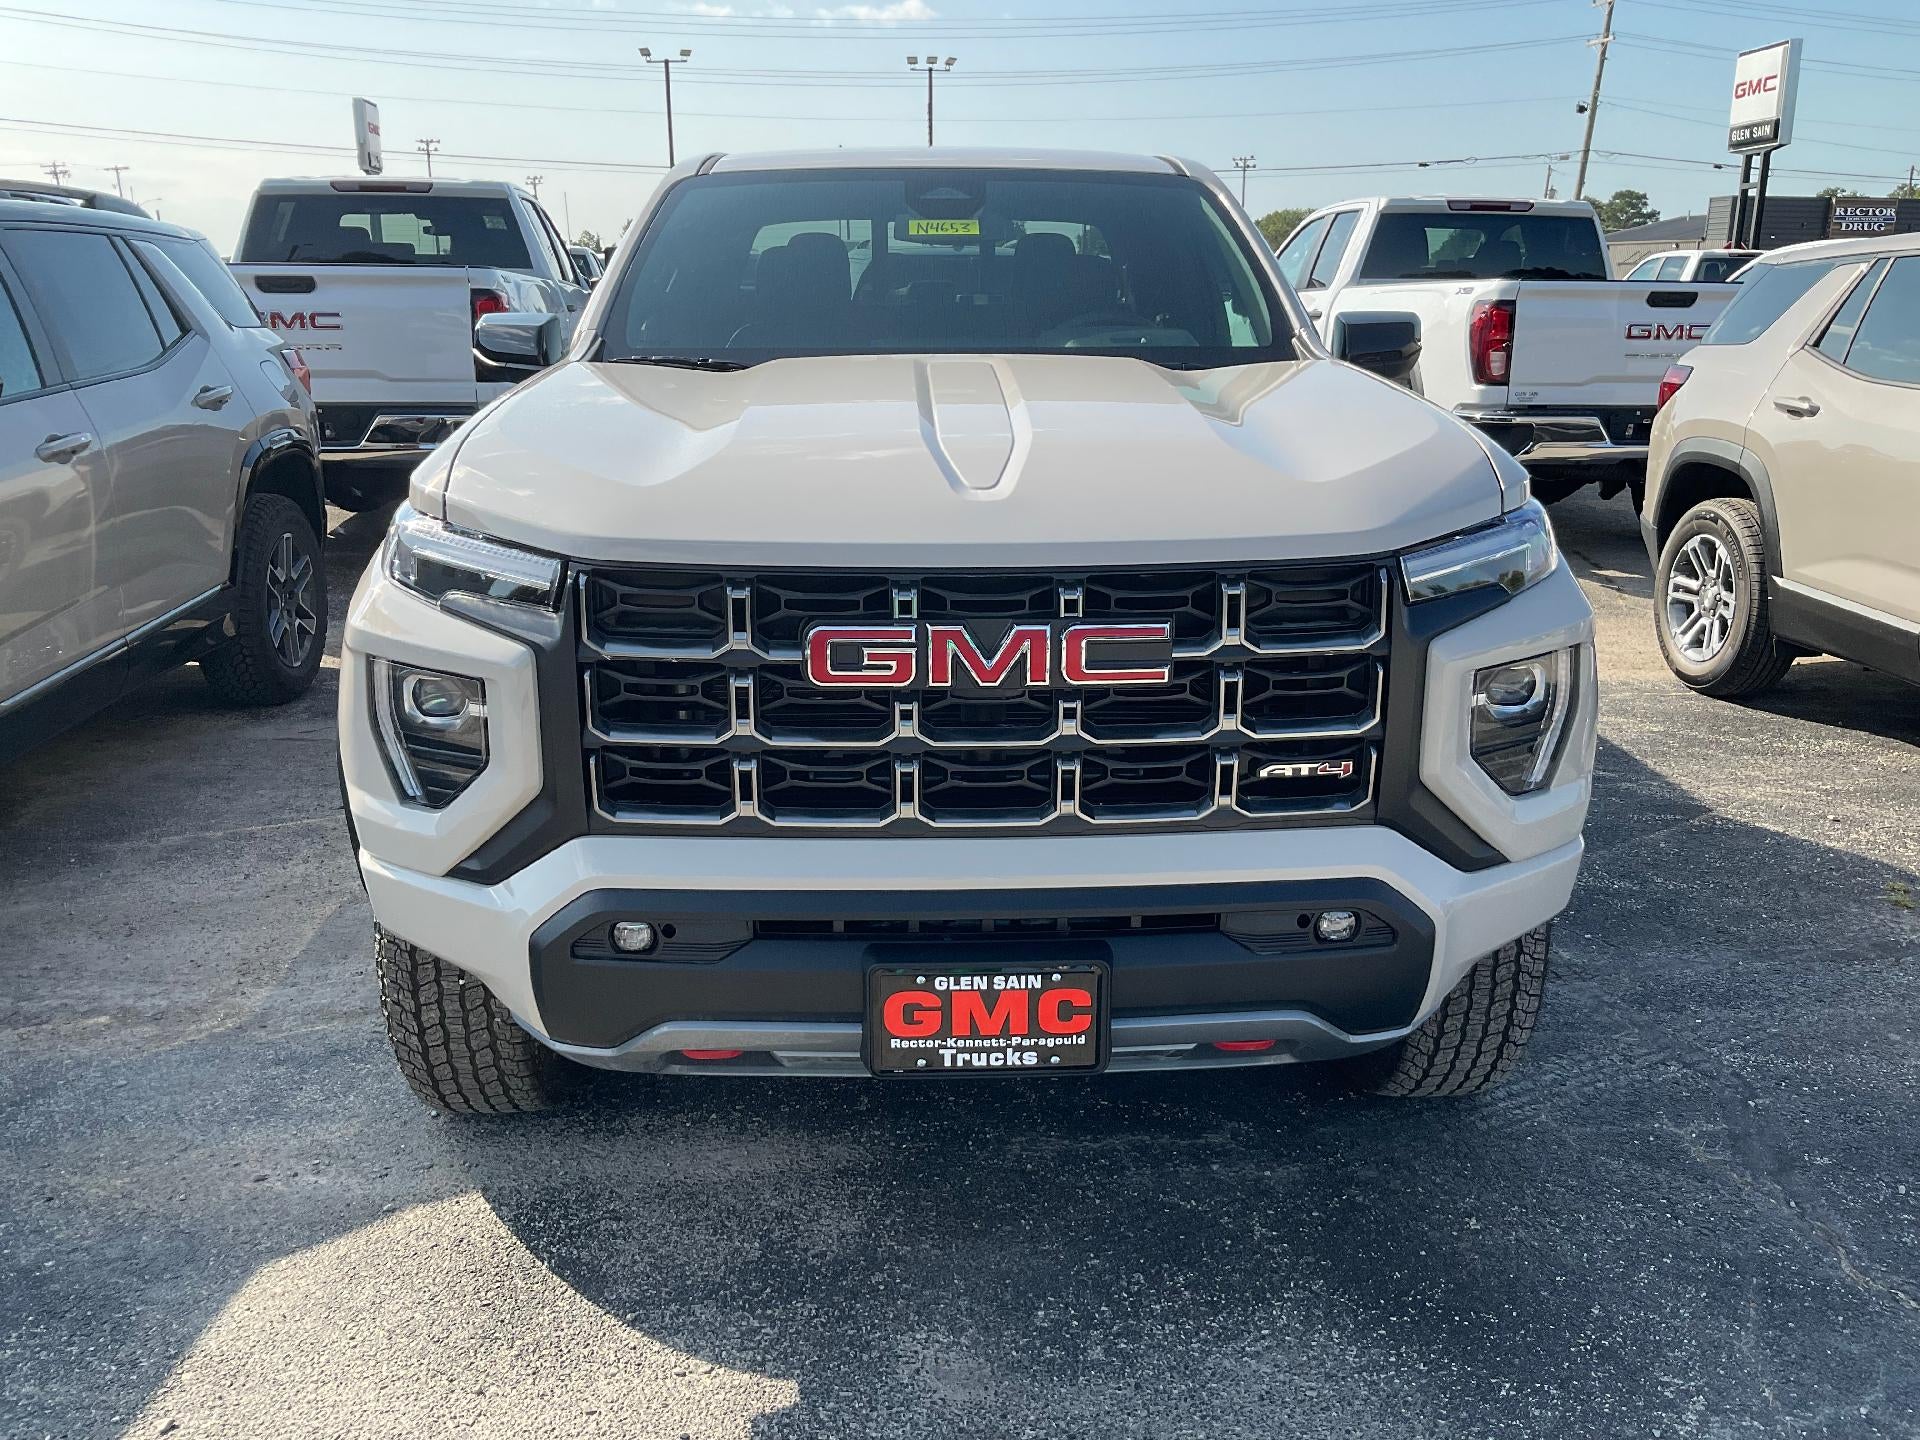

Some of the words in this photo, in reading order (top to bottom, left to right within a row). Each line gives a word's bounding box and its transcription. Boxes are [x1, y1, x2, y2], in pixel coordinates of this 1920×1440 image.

[1734, 74, 1777, 99] GMC
[1731, 129, 1750, 141] GLEN
[1752, 124, 1771, 138] SAIN
[1835, 207, 1896, 216] RECTOR
[916, 222, 971, 234] N4653
[1840, 222, 1885, 231] DRUG
[259, 311, 343, 330] MC
[1624, 323, 1711, 340] GMC
[806, 623, 1172, 687] GMC
[1259, 761, 1353, 779] AT4
[934, 976, 988, 990] GLEN
[993, 975, 1042, 989] SAIN
[883, 988, 1092, 1037] GMC
[939, 1048, 1038, 1067] Trucks
